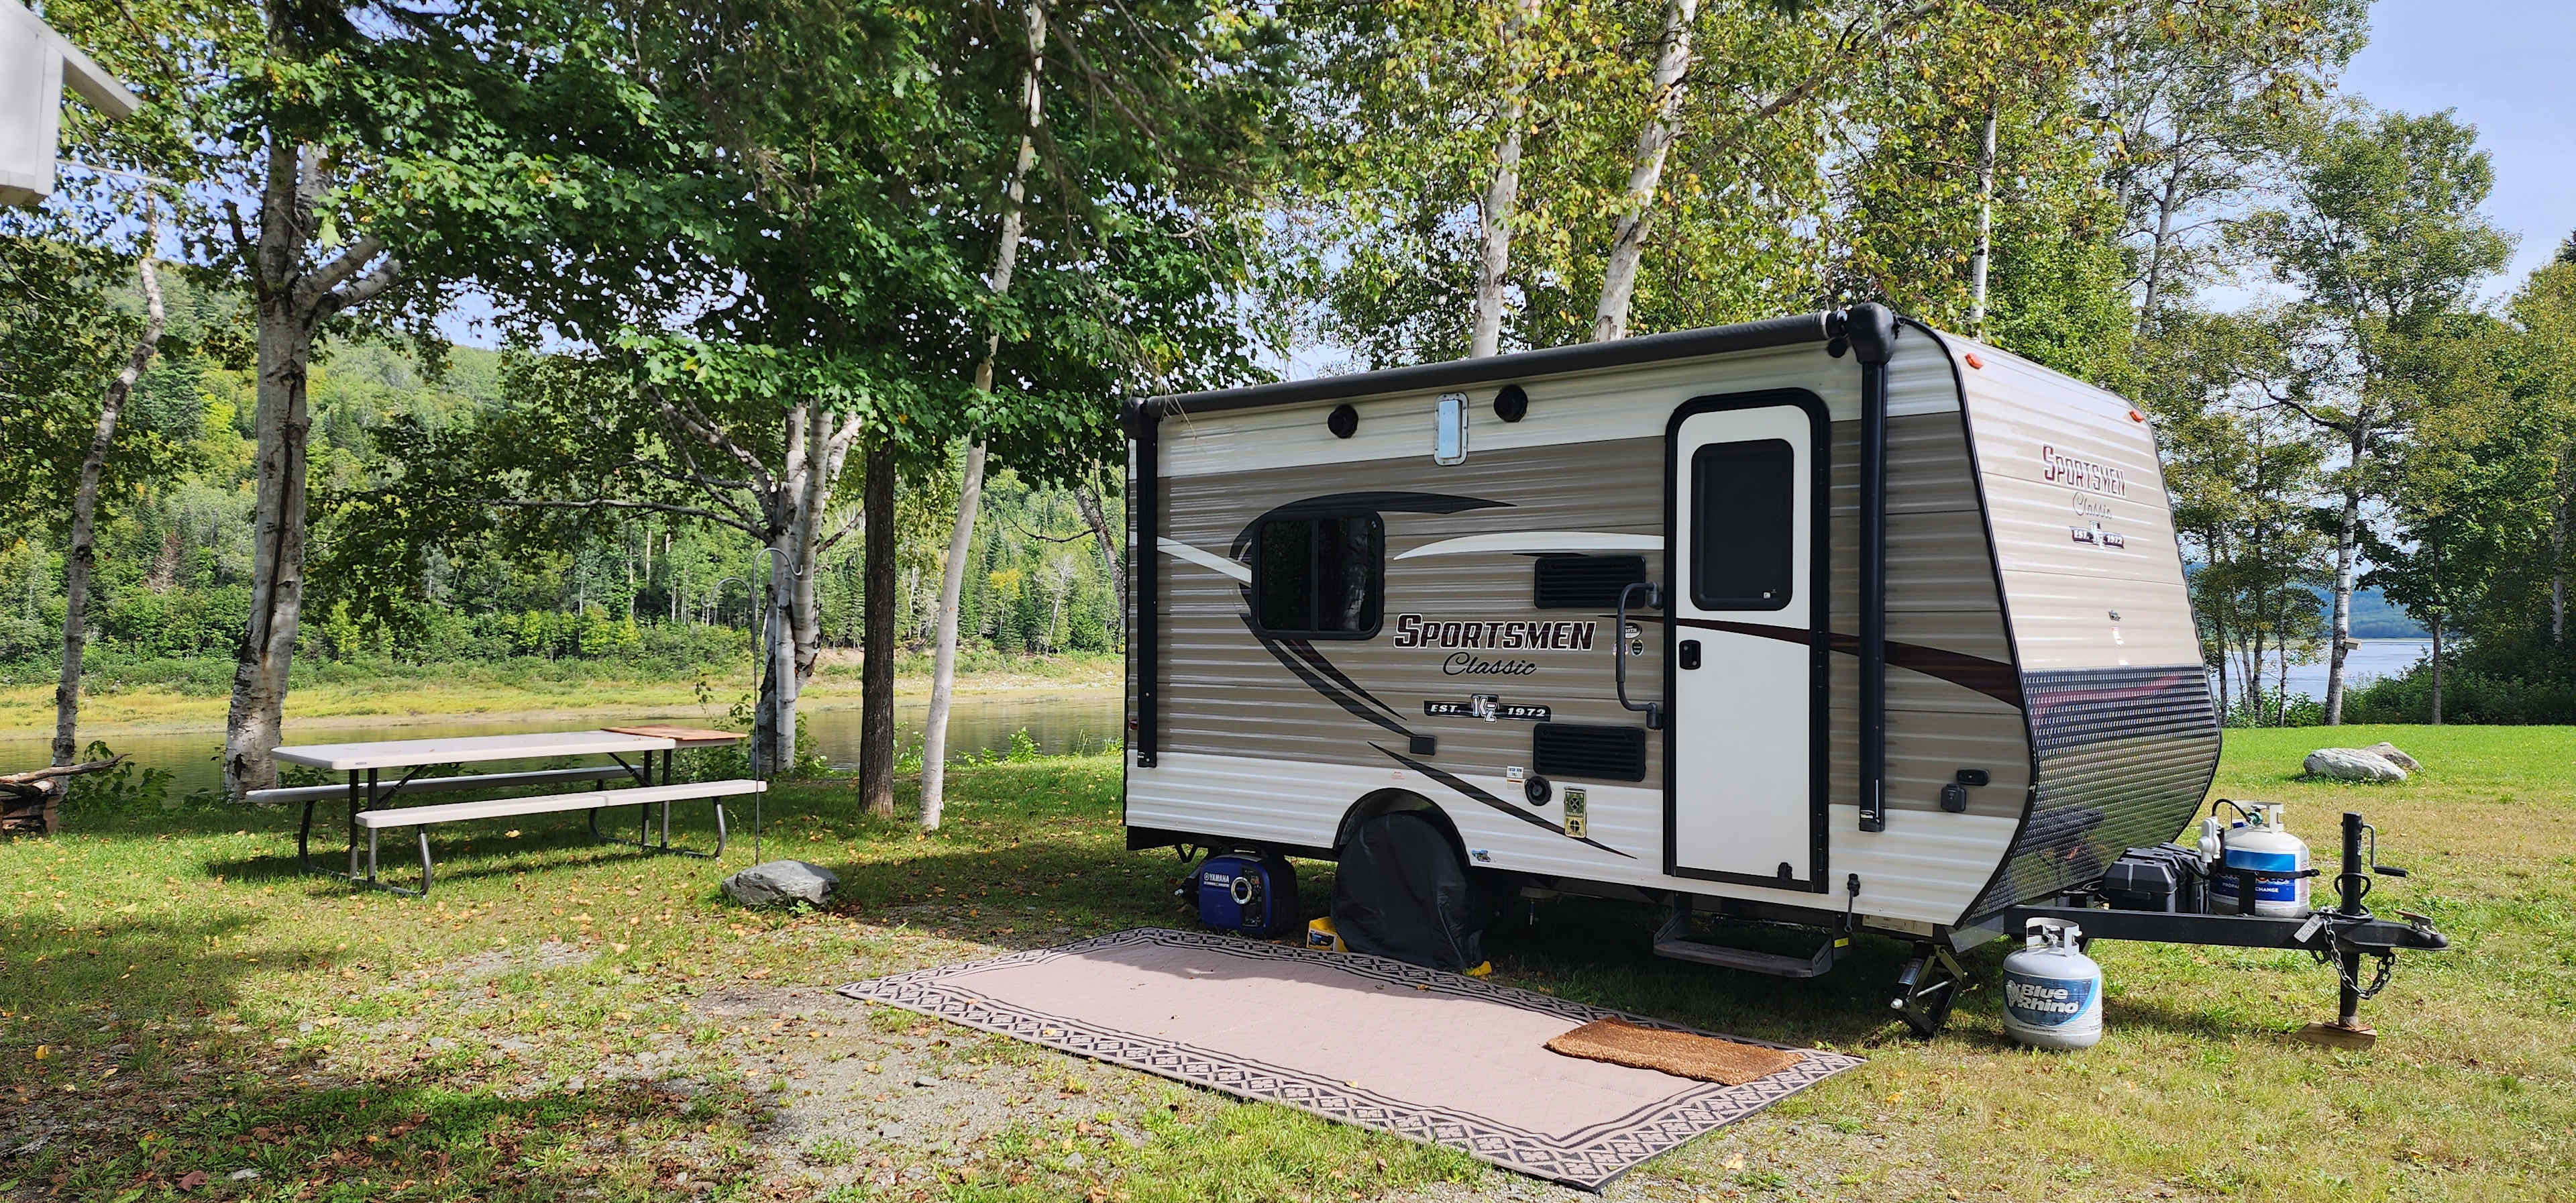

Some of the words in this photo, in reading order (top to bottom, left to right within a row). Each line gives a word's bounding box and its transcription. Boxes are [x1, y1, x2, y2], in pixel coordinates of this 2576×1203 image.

[2041, 442, 2126, 497] SPORTSMEN
[2072, 491, 2113, 519] Classic
[1393, 613, 1597, 651] SPORTSMEN
[1443, 651, 1537, 676] Classic
[1430, 704, 1460, 713] EST.
[1508, 707, 1546, 717] 1972
[1210, 873, 1230, 883] YAMAHA
[2022, 984, 2068, 1000] Blue
[2018, 997, 2078, 1014] Rhino
